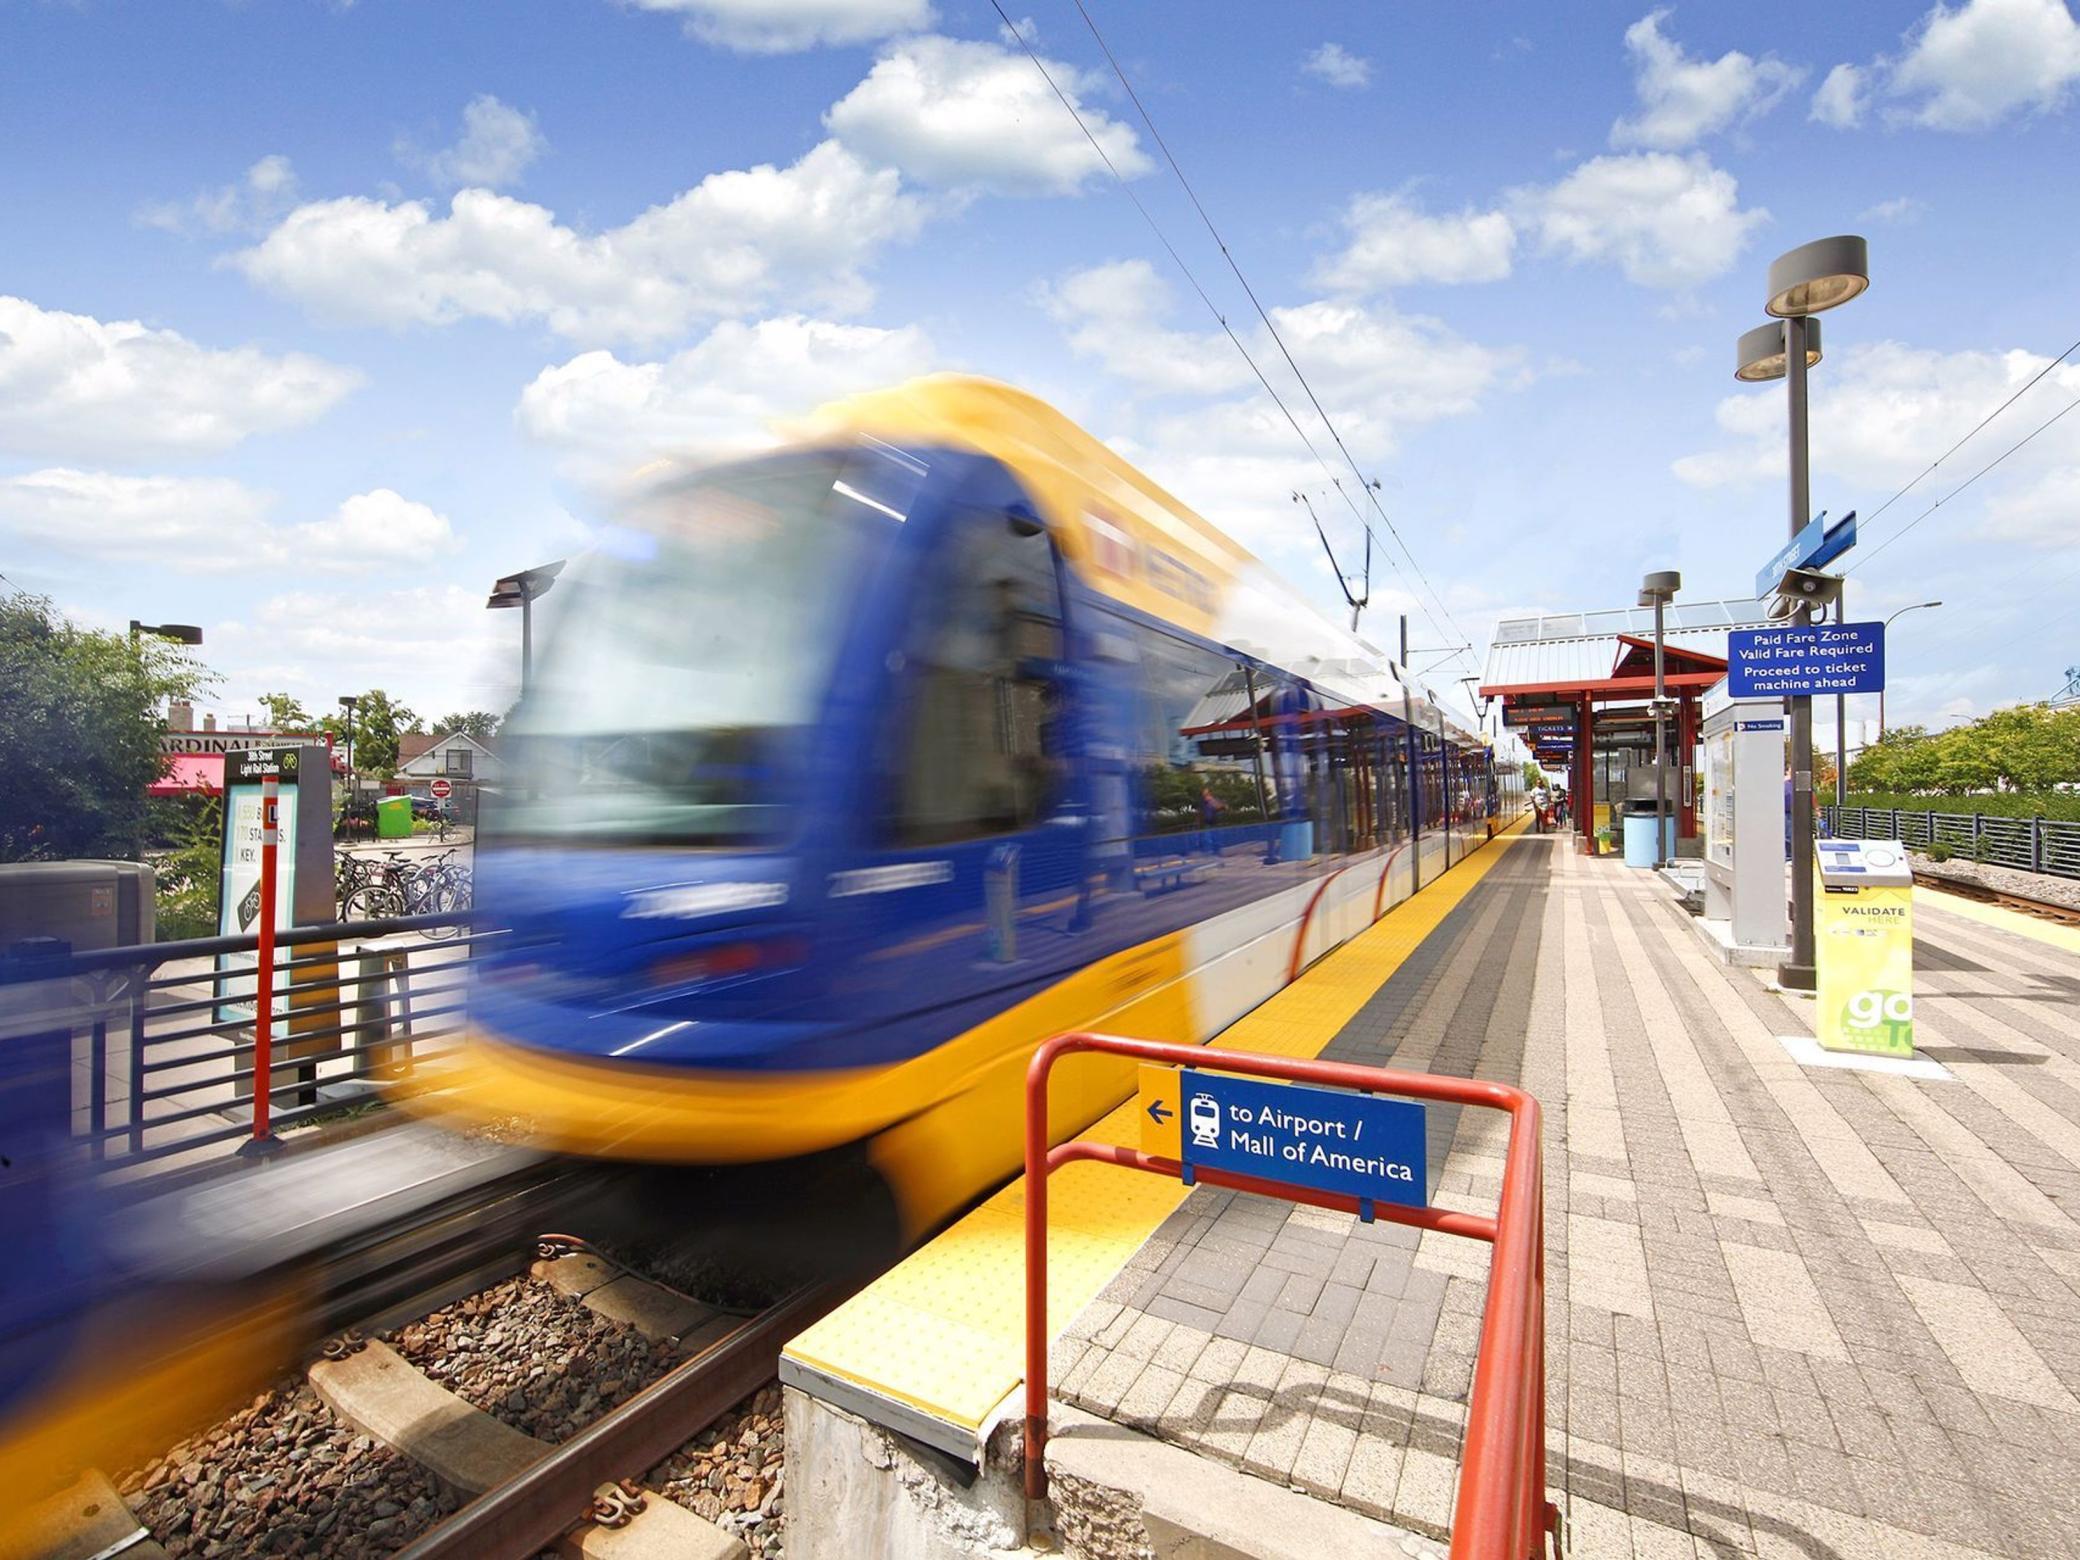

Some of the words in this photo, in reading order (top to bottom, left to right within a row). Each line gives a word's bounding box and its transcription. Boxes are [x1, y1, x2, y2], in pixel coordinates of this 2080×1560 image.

[1754, 634, 1781, 646] Paid
[1786, 633, 1816, 644] Fare
[1820, 631, 1858, 642] Zone
[1739, 649, 1771, 660] Valid
[1775, 648, 1805, 658] Fare
[1810, 643, 1873, 657] Required
[1744, 665, 1800, 677] Proceed
[1805, 665, 1820, 674] to
[1825, 662, 1867, 673] ticket
[1754, 679, 1810, 690] machine
[1815, 676, 1856, 688] ahead
[159, 738, 250, 754] ARDINA
[258, 750, 273, 761] Street
[240, 762, 252, 777] Light
[253, 762, 262, 774] Rail
[262, 762, 280, 774] Station
[1842, 906, 1905, 916] VALIDATE
[1867, 915, 1900, 925] HERE
[1847, 990, 1912, 1030] go
[1229, 1104, 1253, 1123] to
[1258, 1105, 1346, 1138] Airport
[1353, 1120, 1363, 1141] /
[1230, 1130, 1274, 1157] Mall
[1282, 1142, 1307, 1163] of
[1310, 1145, 1413, 1182] America
